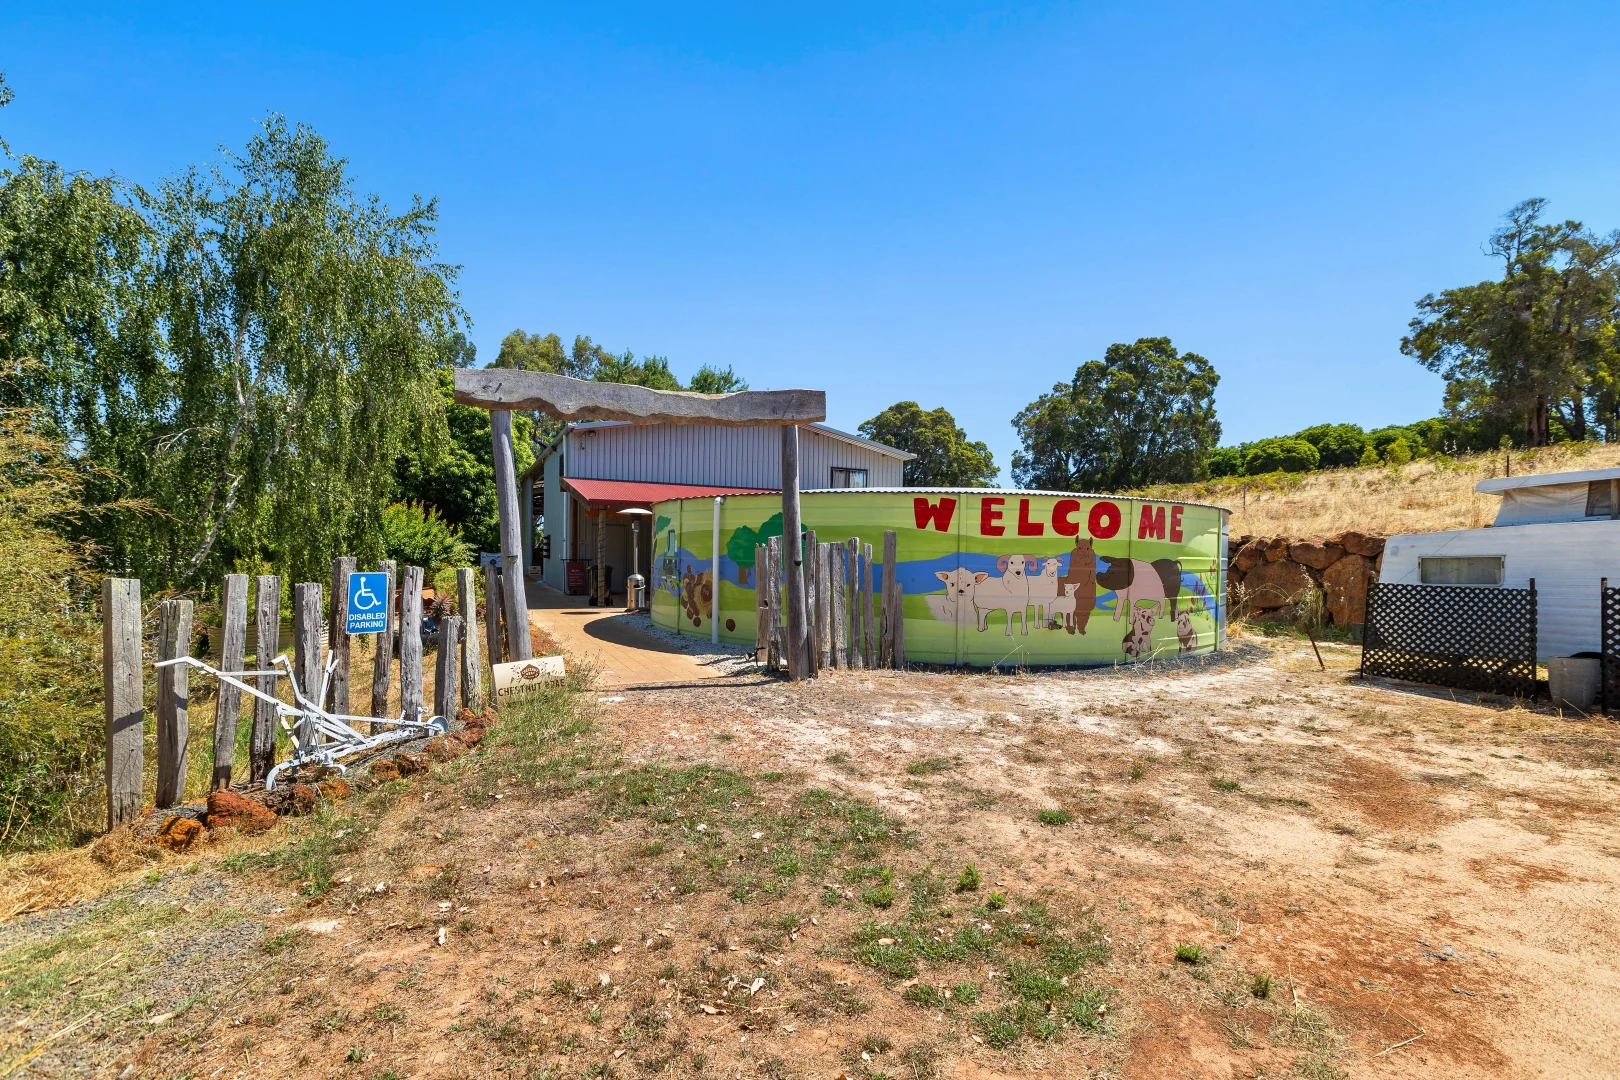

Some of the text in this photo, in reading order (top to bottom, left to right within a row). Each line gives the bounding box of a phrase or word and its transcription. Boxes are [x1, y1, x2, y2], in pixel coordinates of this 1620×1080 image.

[913, 497, 1184, 543] WELCOME
[349, 612, 385, 621] DISABLED
[350, 621, 383, 629] PARKING
[498, 682, 542, 697] CHESTNUT
